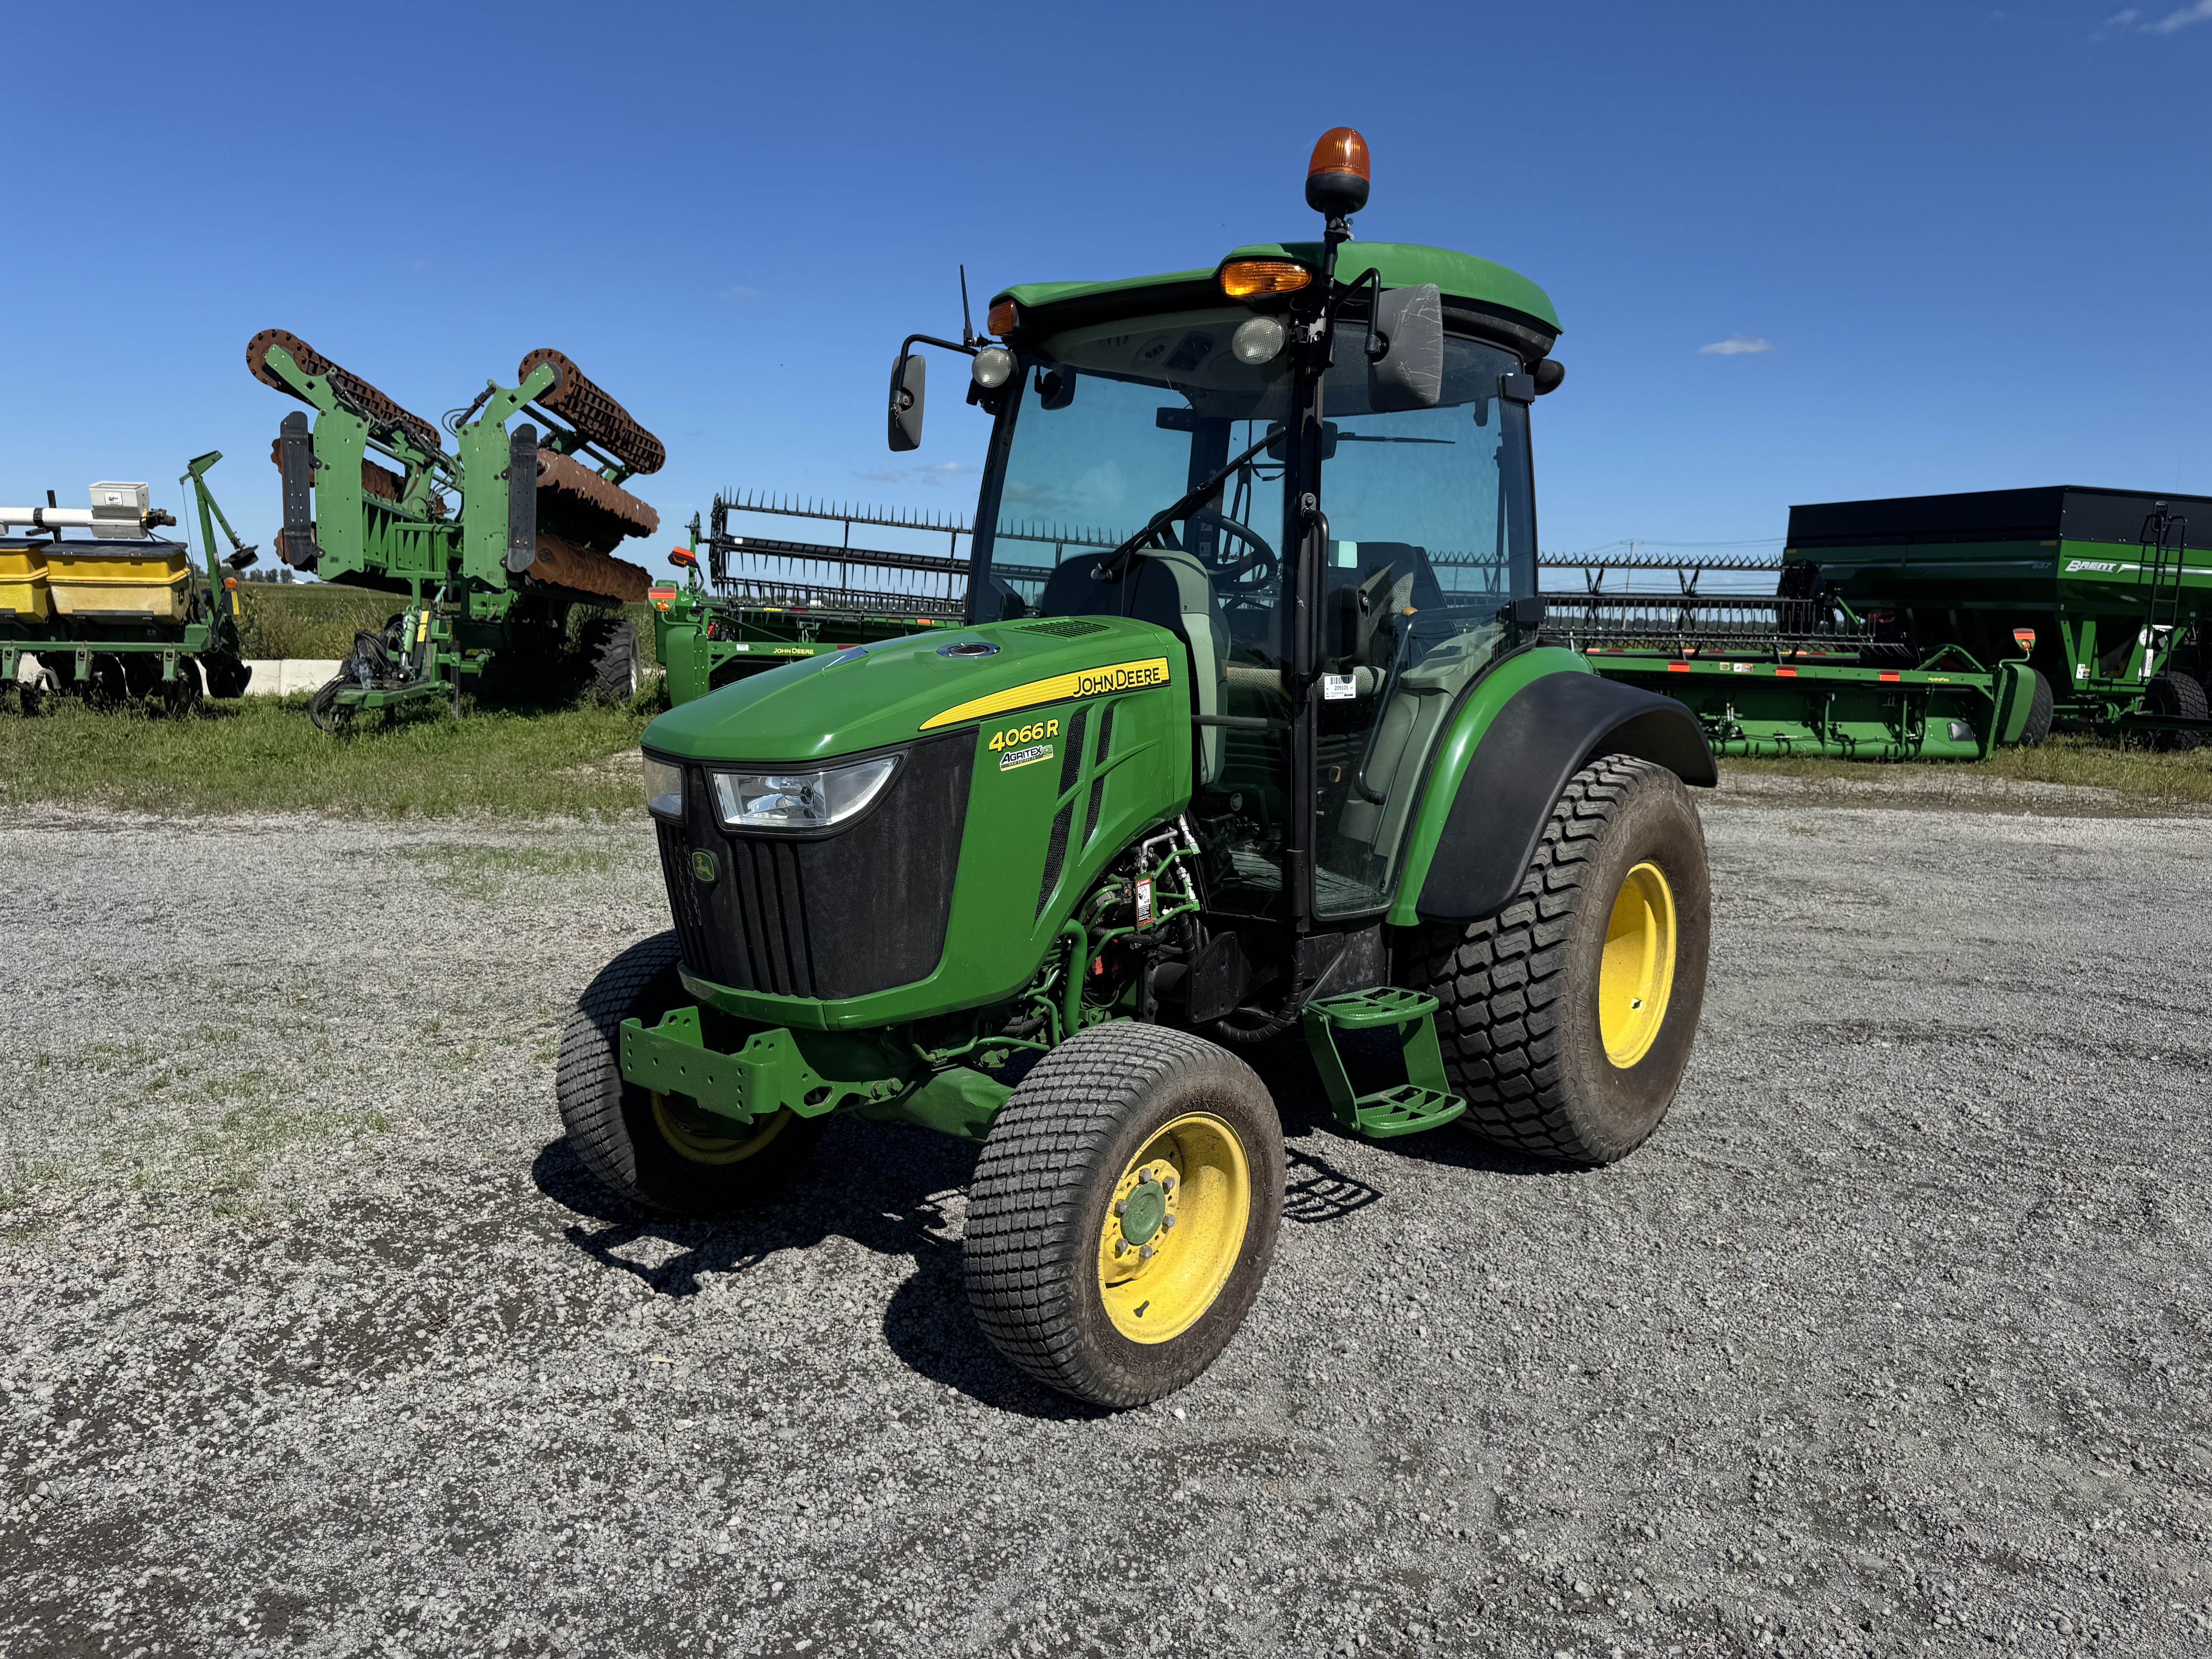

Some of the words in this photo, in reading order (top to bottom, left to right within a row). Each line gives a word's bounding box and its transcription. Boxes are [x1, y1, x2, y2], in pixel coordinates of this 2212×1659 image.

[2064, 560, 2117, 572] BRENT
[1073, 674, 1114, 695] JOHN
[1116, 667, 1160, 687] DEERE
[1001, 747, 1042, 764] AGRITEX
